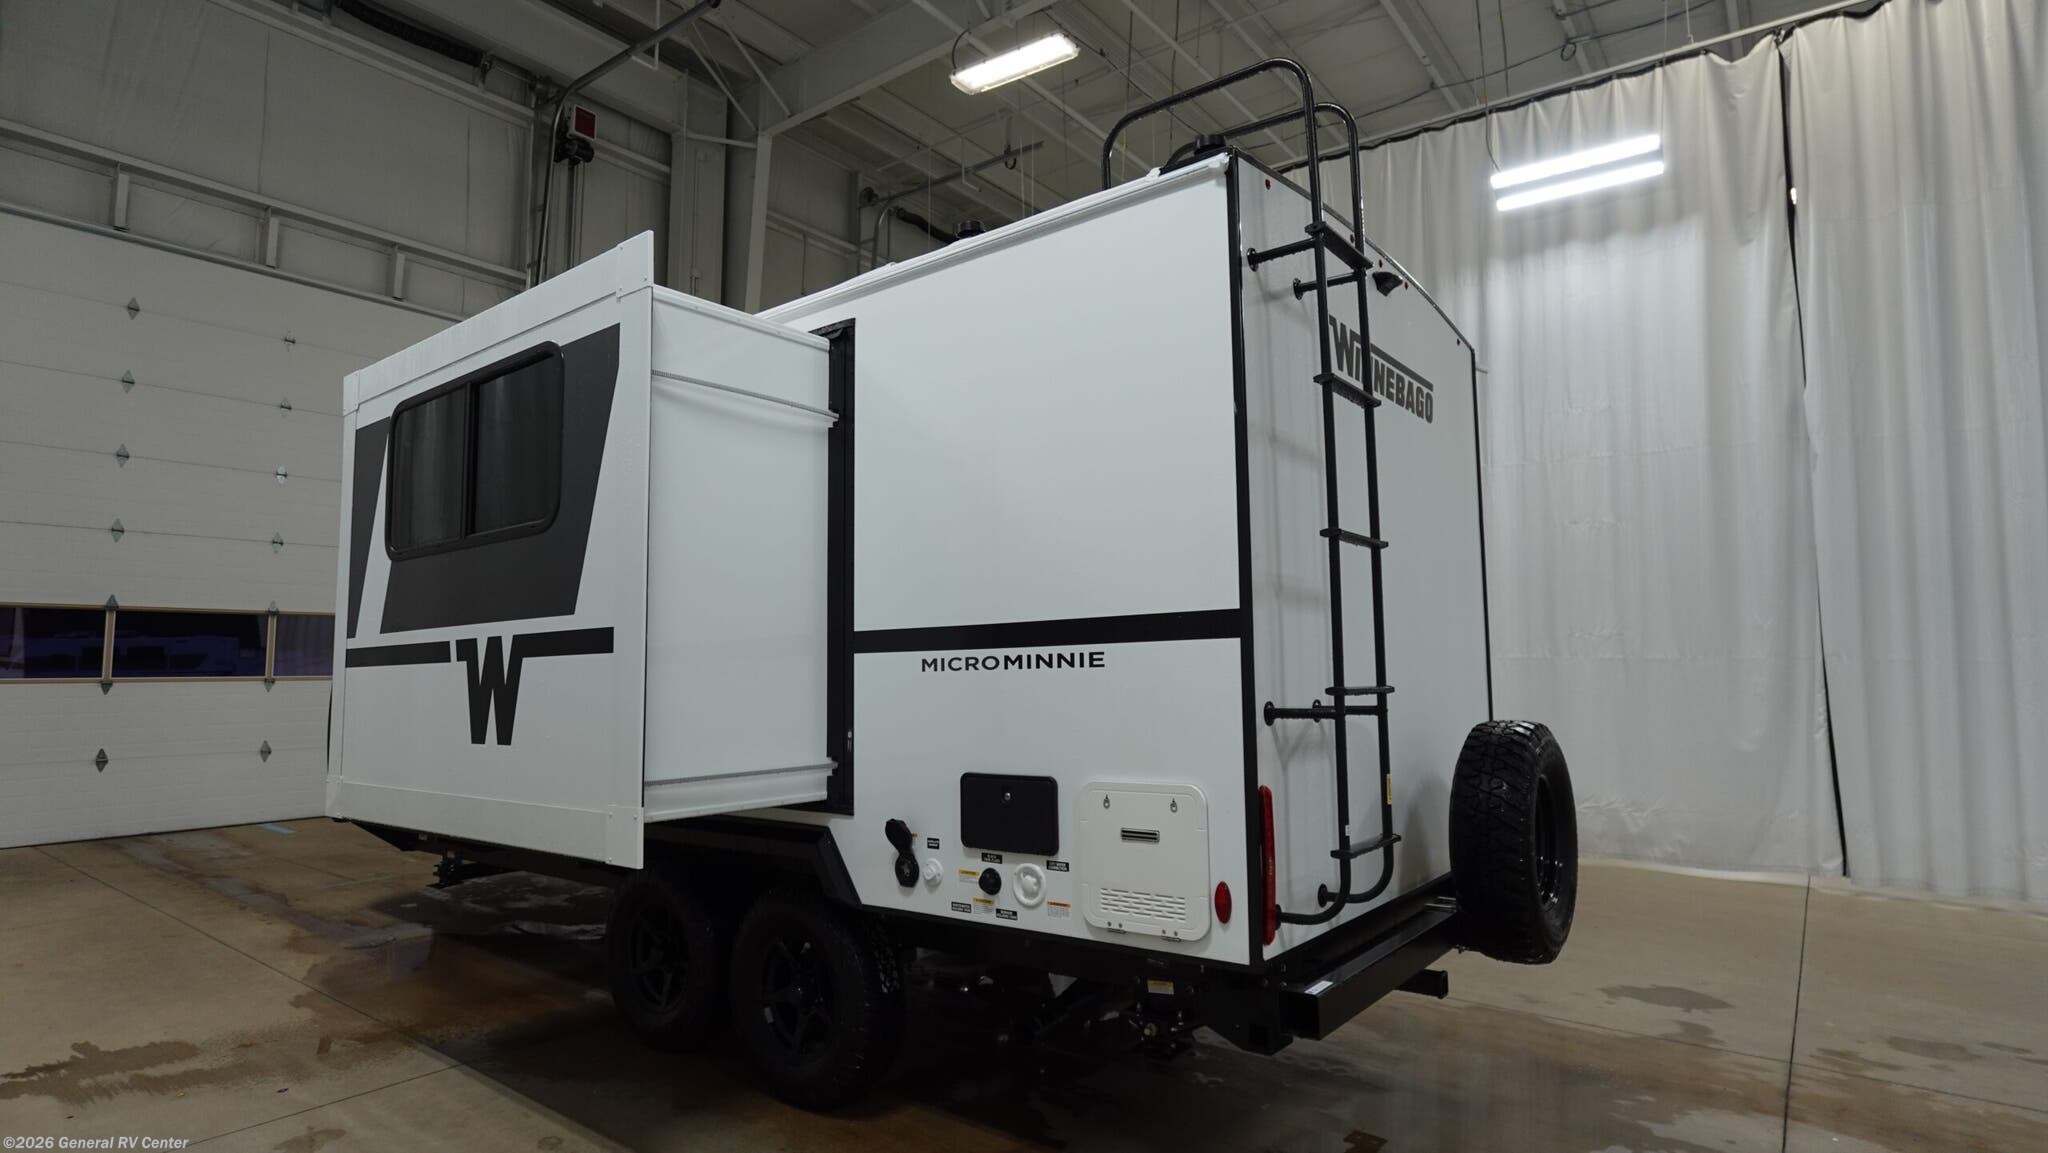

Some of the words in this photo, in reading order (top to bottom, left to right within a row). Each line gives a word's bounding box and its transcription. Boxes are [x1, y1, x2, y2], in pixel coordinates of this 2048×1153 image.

[1328, 313, 1434, 424] WINEBAGO
[456, 635, 524, 746] W
[921, 651, 1106, 673] MICROMINNIE
